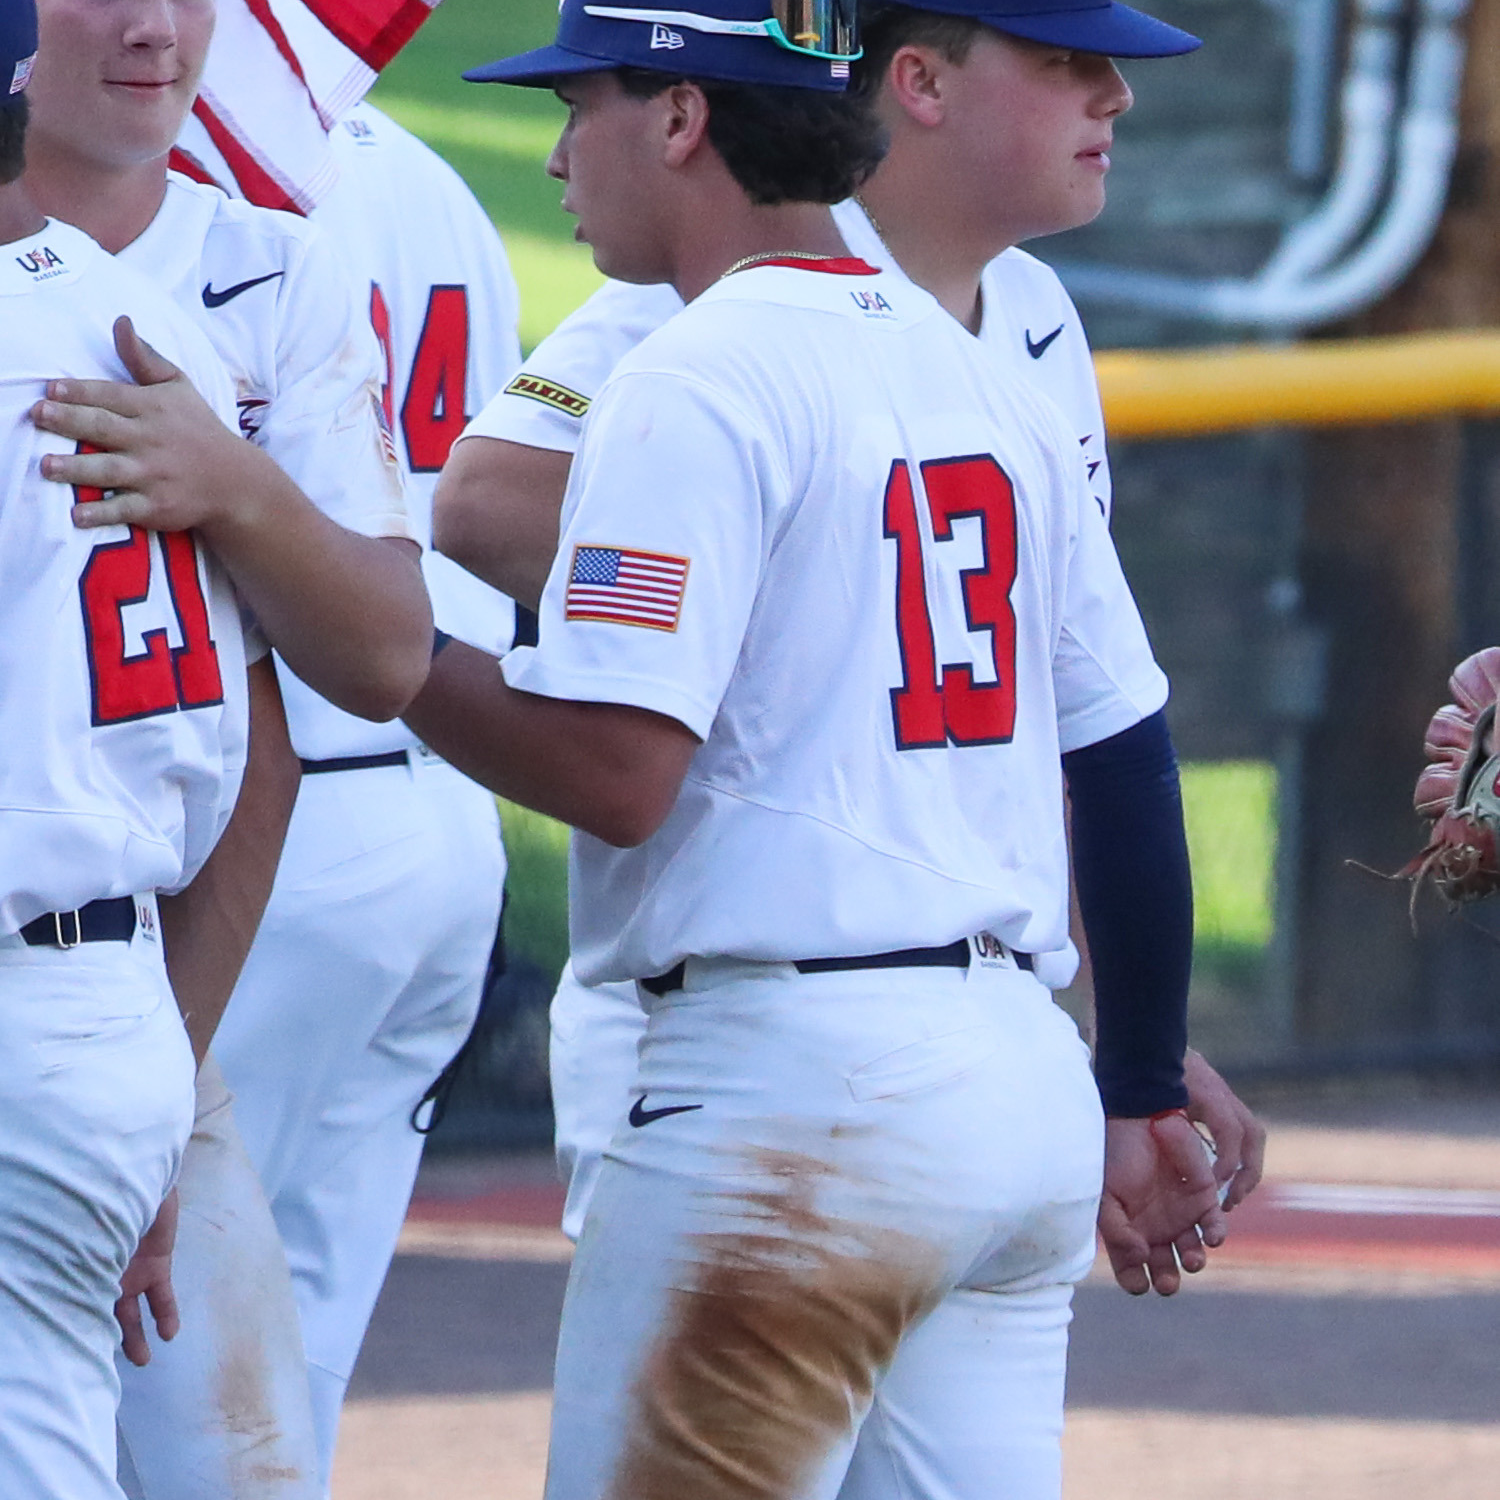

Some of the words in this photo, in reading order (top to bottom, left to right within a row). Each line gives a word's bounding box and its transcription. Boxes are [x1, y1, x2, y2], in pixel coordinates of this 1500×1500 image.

[15, 246, 64, 273] USA
[511, 379, 588, 411] PANINI
[883, 453, 1018, 751] 13
